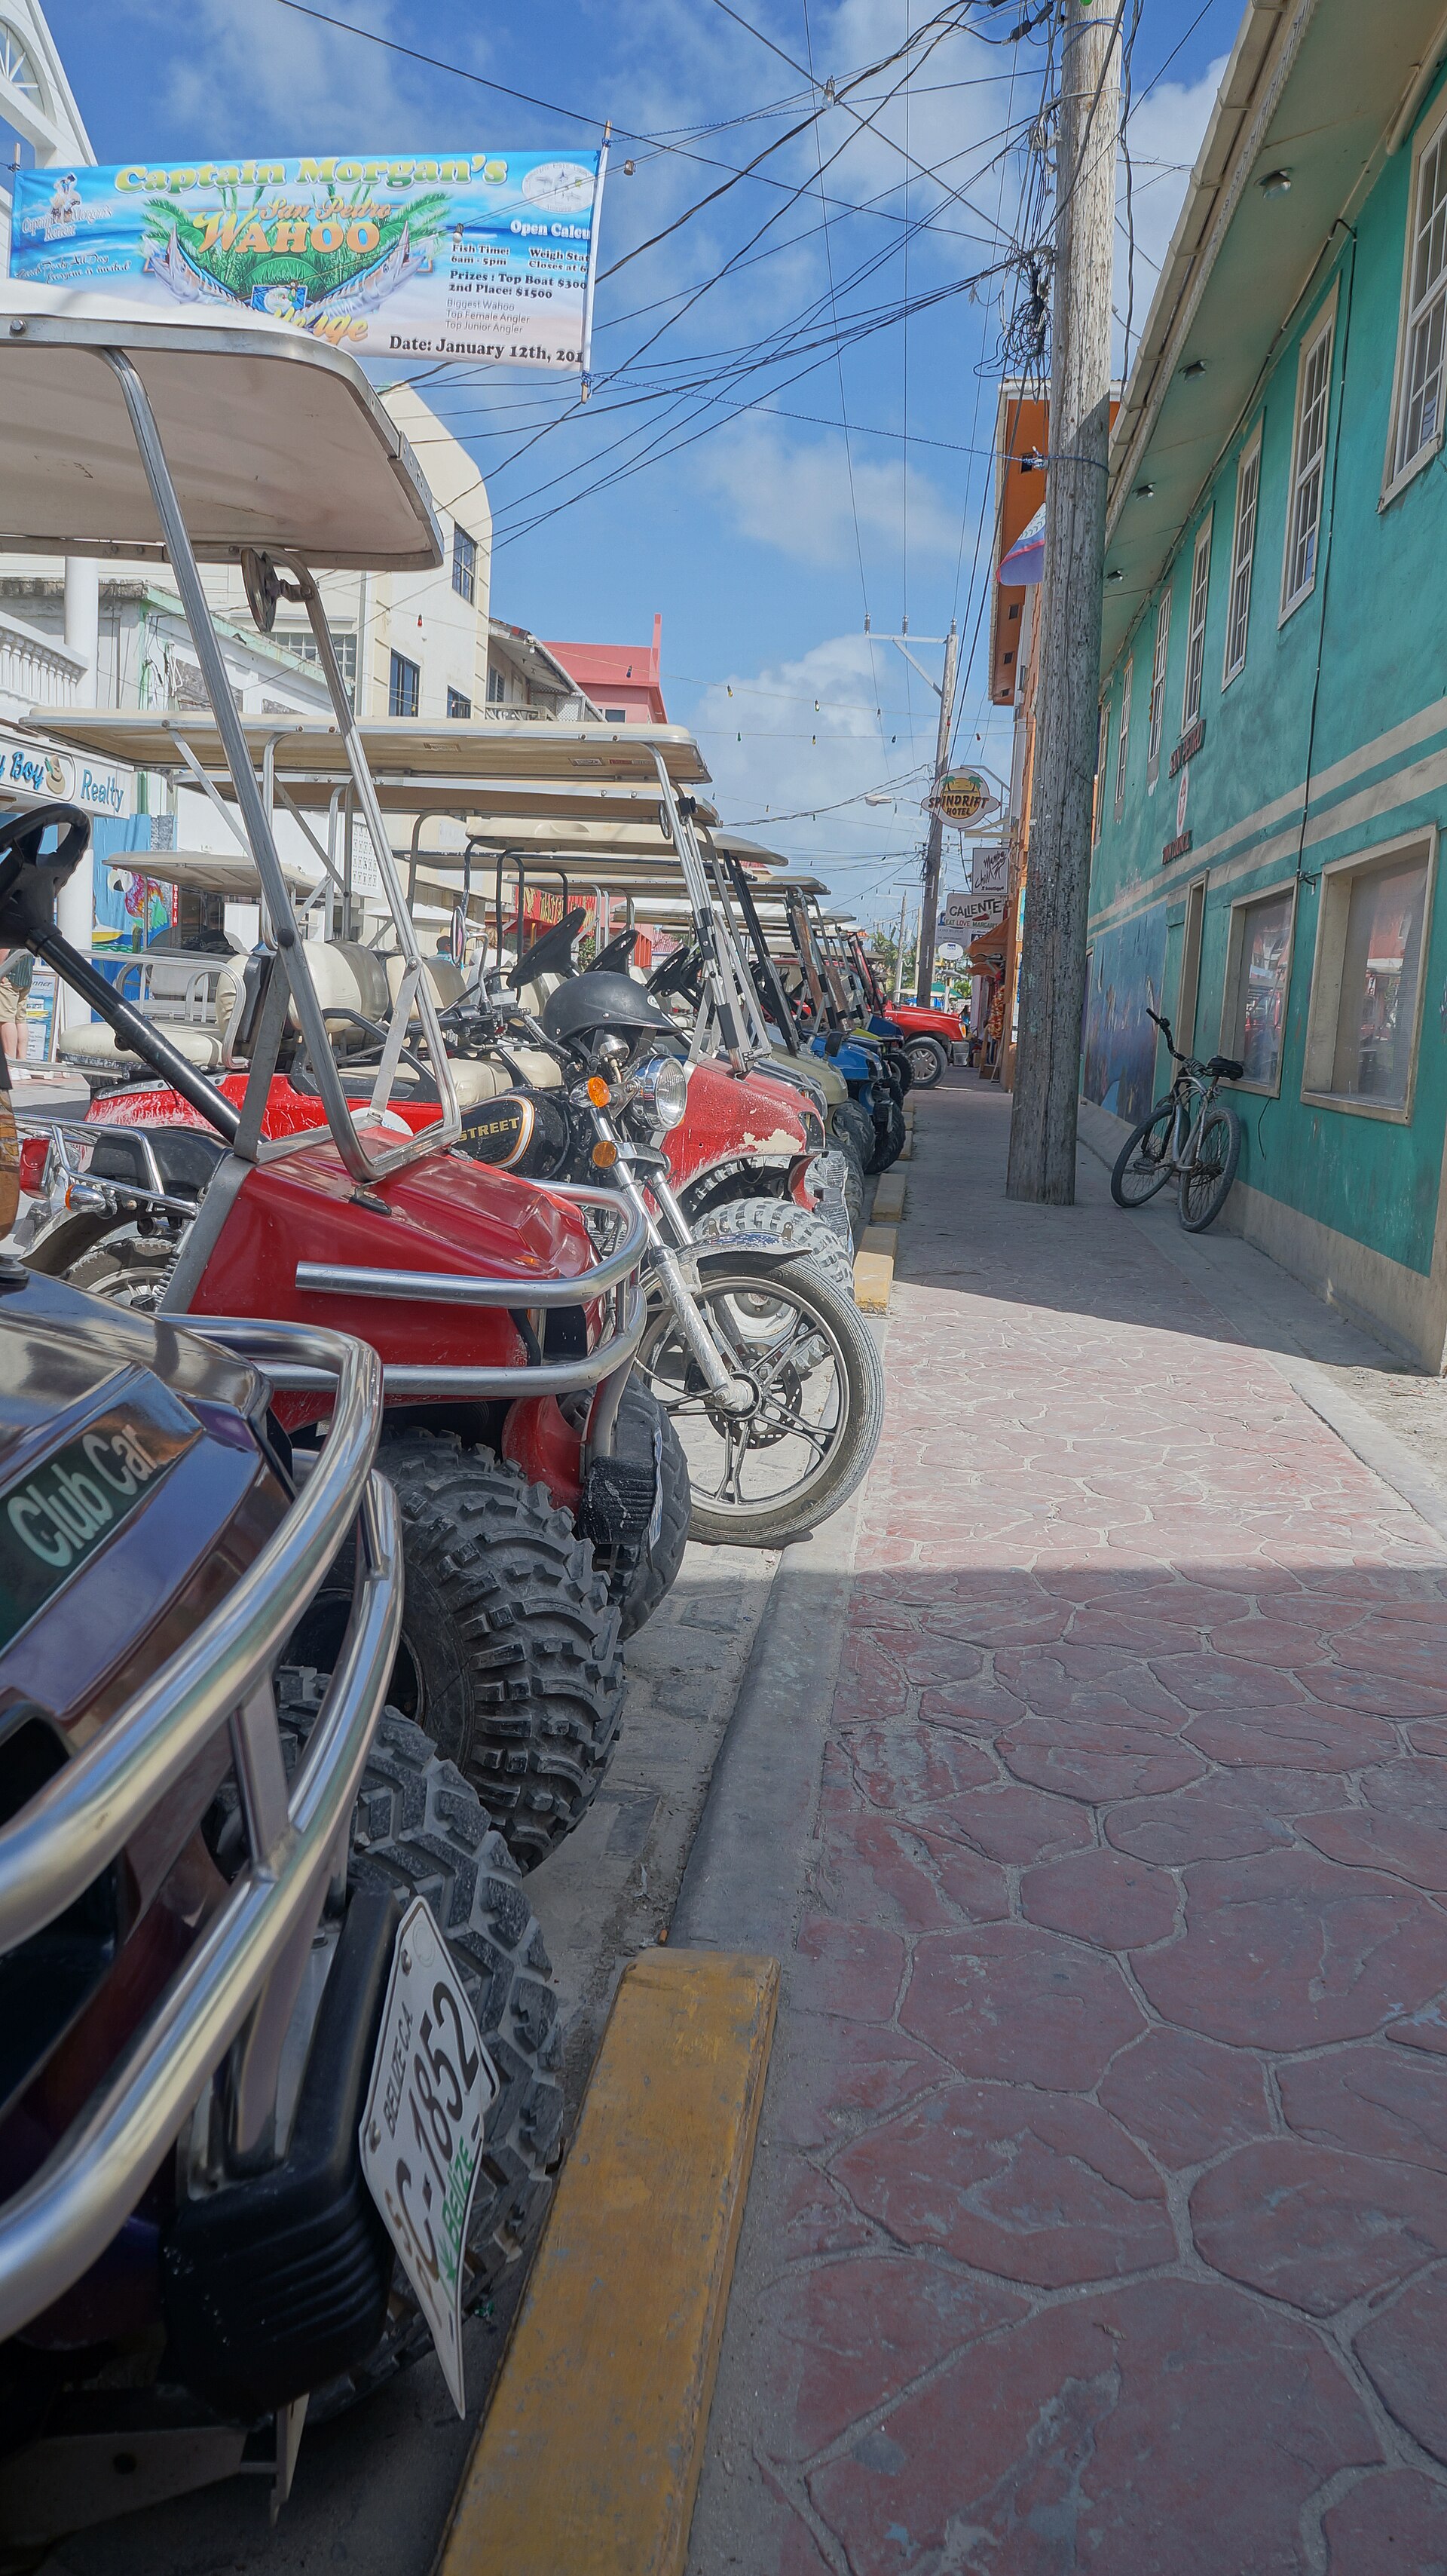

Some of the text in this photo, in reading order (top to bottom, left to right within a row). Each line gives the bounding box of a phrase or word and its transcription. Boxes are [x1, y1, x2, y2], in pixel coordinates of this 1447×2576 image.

[116, 160, 286, 196] Captain
[295, 155, 508, 190] Morgan's
[259, 196, 393, 220] San Pedro
[193, 208, 380, 253] WAHOO
[510, 219, 548, 236] Open
[452, 244, 476, 253] Fish
[530, 249, 563, 260] Weigh
[483, 258, 506, 266] 5pm
[529, 261, 562, 270] Closes
[450, 270, 488, 281] Prizes
[499, 273, 521, 284] Top
[525, 275, 553, 286] Boat
[448, 283, 472, 293] 2nd
[516, 288, 552, 299] $1500
[447, 299, 514, 311] Biggest Wahoo
[447, 310, 530, 324] Top Female Angler
[445, 320, 523, 335] Top Junior Angler
[389, 335, 432, 351] Date:
[436, 338, 504, 359] January
[510, 345, 551, 363] 12th,
[11, 751, 44, 791] Boy
[81, 768, 124, 813] Realty
[928, 795, 990, 809] SPINDRIFT
[947, 807, 971, 816] HOTEL
[949, 899, 1002, 918] CALIENTE
[459, 1116, 520, 1142] STREET
[7, 1424, 157, 1567] Club Car
[383, 2036, 407, 2140] BELIZE
[396, 1982, 479, 2283] C-1852
